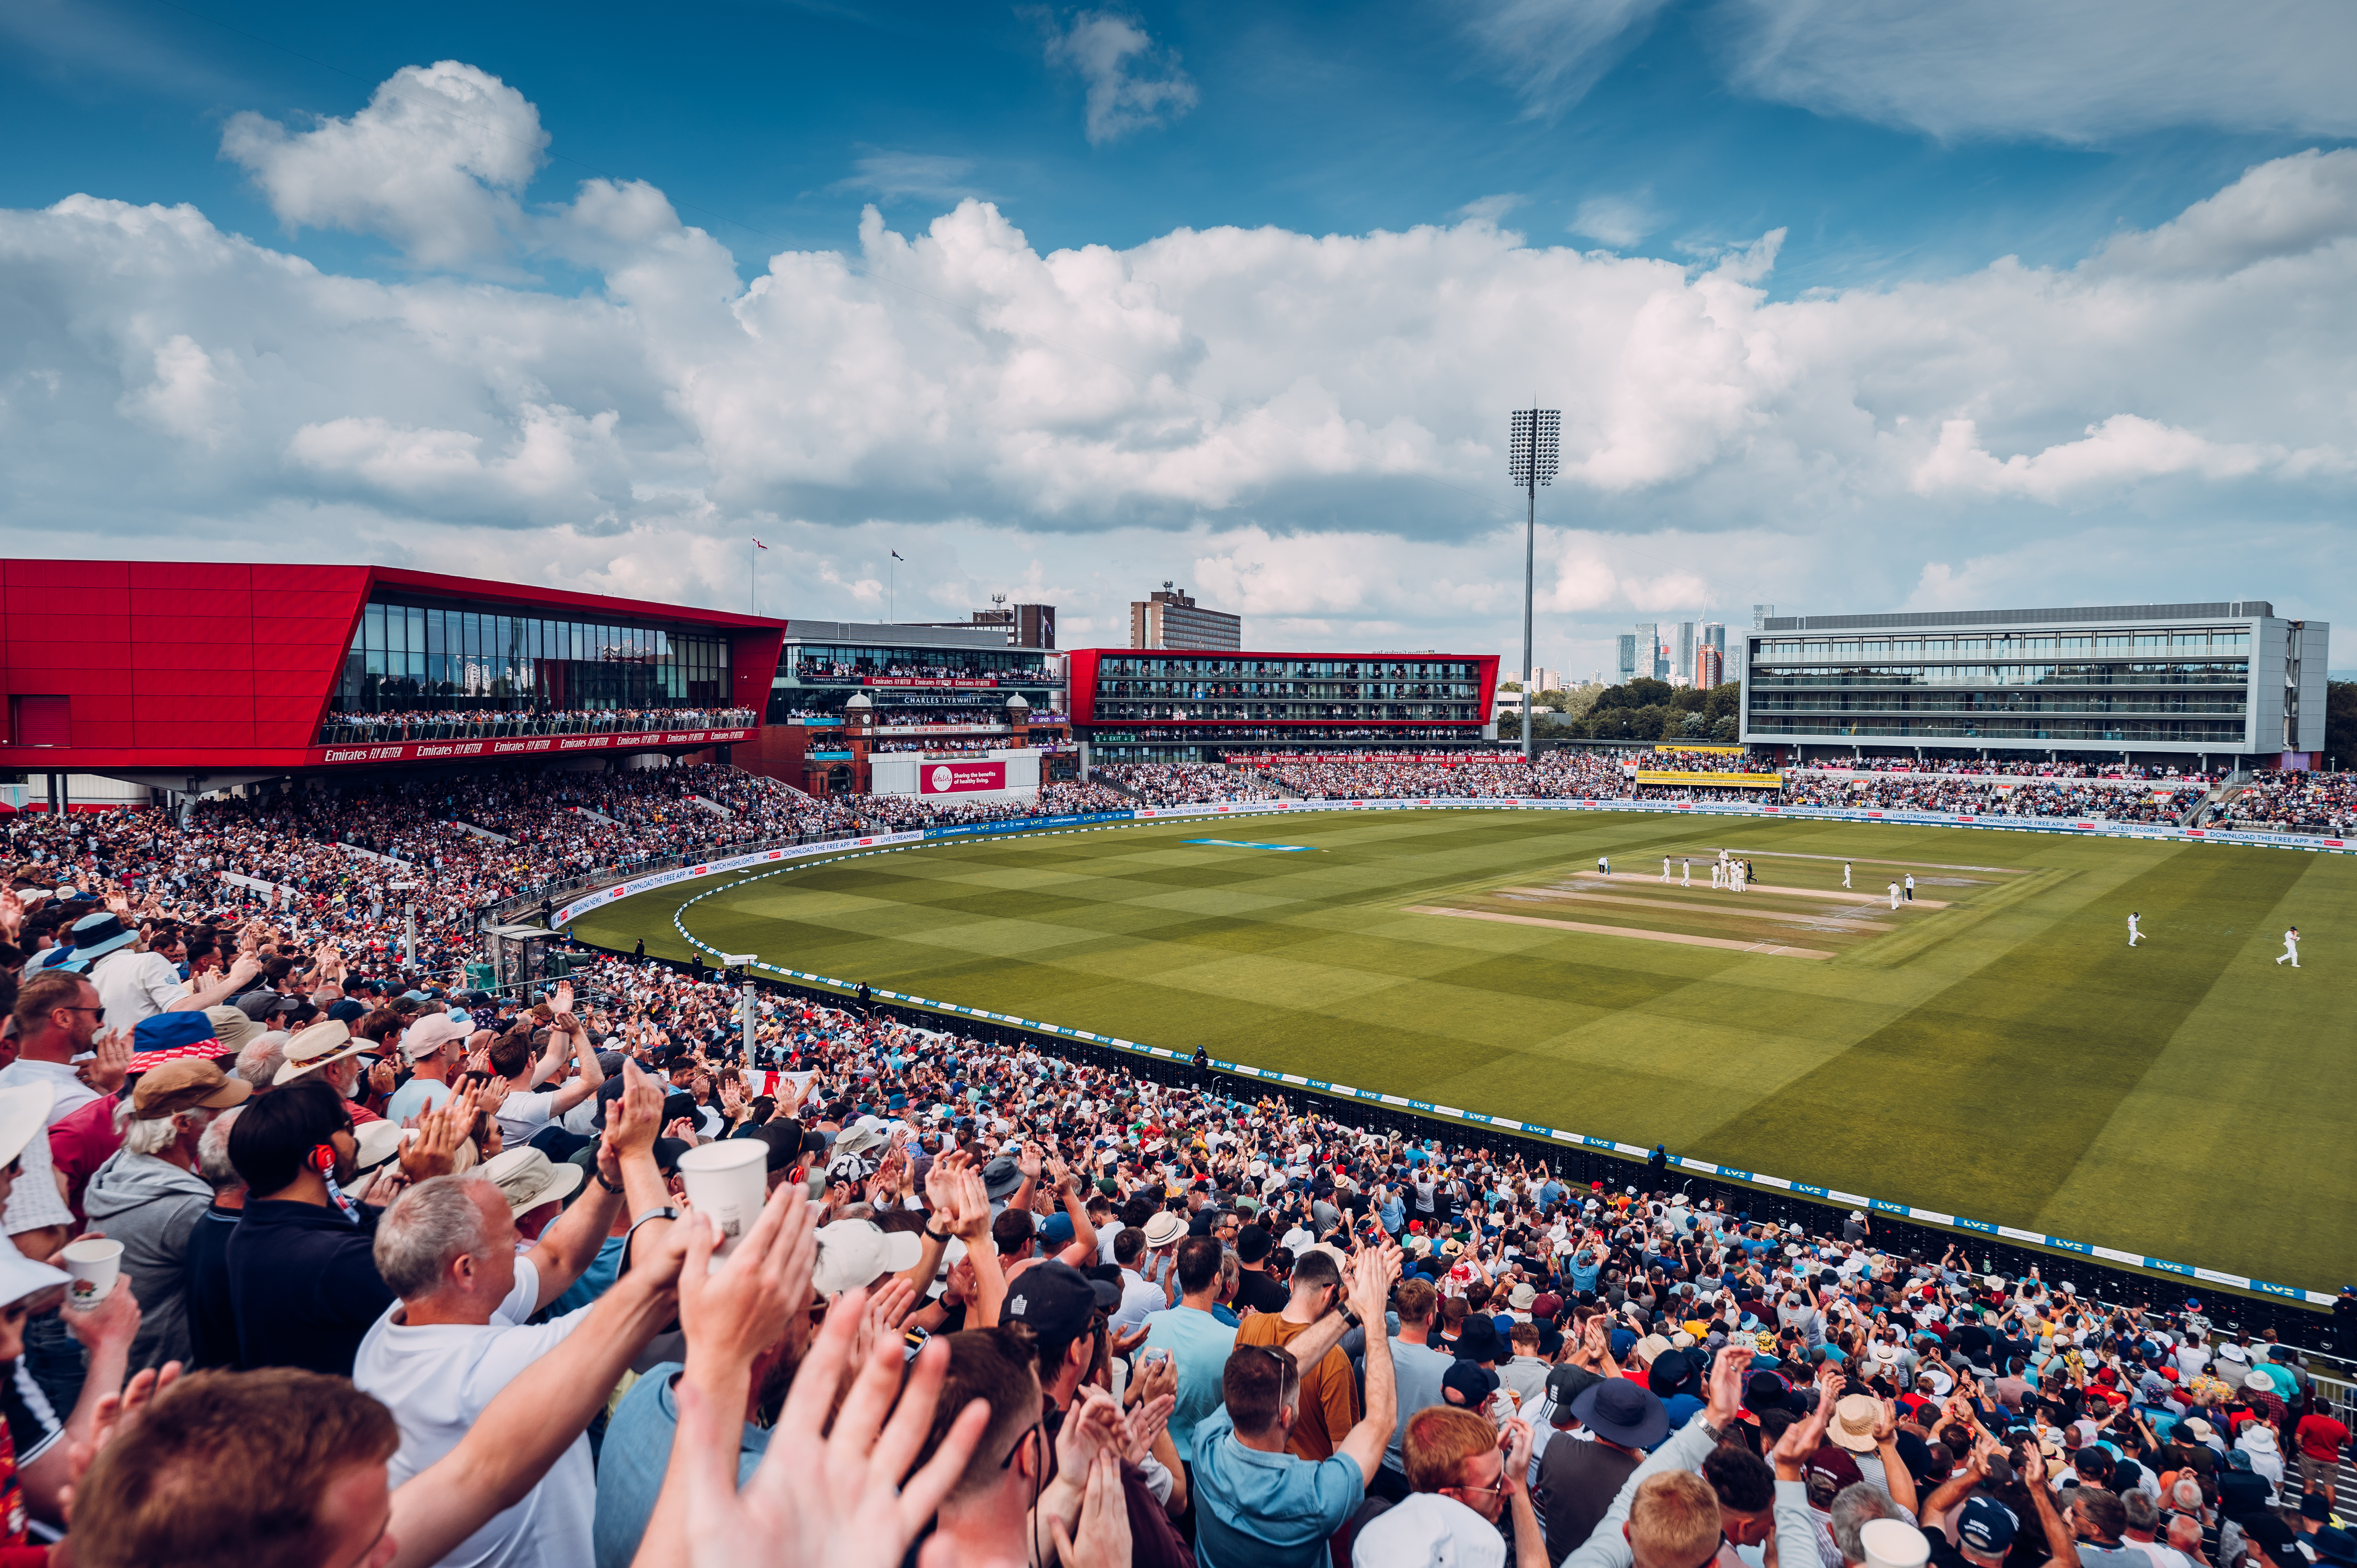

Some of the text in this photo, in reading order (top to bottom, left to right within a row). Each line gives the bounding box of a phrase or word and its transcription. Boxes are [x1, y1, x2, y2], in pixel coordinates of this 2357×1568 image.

[560, 739, 587, 749] Emirates
[594, 737, 609, 746] BETTER
[617, 736, 640, 745] Emirates
[647, 735, 660, 743] BETTER
[417, 743, 483, 756] Emirates FLY BETTER
[494, 740, 550, 752] Emirates FLY BETTER
[325, 747, 403, 762] Emirates FLY BETTER
[933, 773, 951, 784] Vitality
[892, 833, 920, 842] STREAMING
[784, 846, 814, 856] DOWNLOAD
[710, 856, 754, 871] MATCH HIGHLIGHTS
[627, 880, 653, 892] DOWNLOAD
[664, 873, 675, 882] FREE
[676, 871, 686, 880] APP
[572, 895, 601, 914] BREAKING NEWS
[1684, 1161, 1714, 1171] LV.com/insurance
[1832, 1194, 1865, 1203] LV.com/insurance
[2002, 1230, 2041, 1241] LV.com/insurance
